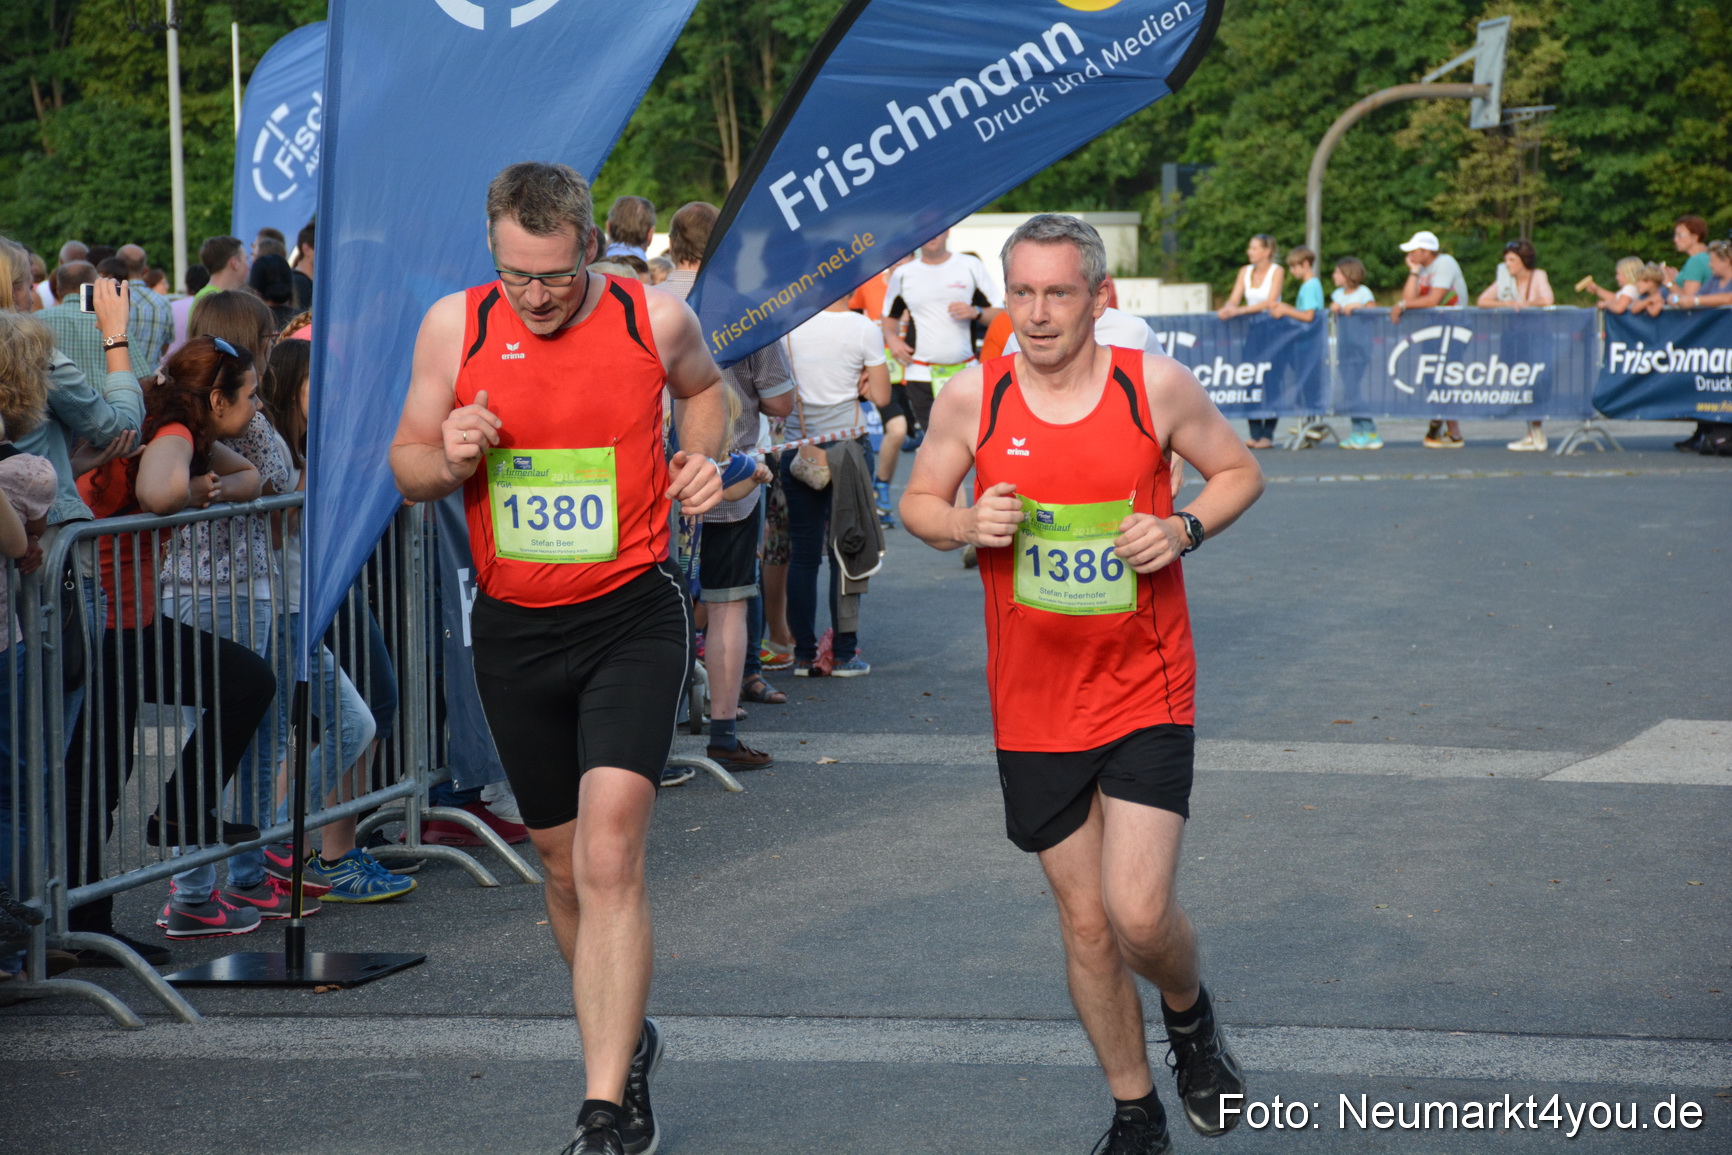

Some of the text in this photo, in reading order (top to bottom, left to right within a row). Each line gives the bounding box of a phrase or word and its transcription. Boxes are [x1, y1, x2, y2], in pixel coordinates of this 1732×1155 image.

[973, 1, 1191, 142] Druck und Medien
[769, 22, 1085, 231] Frischmann
[1415, 354, 1545, 386] Fischer
[1427, 389, 1533, 404] AUTOMOBILE
[503, 494, 603, 531] 1380
[531, 539, 554, 547] Stefan
[1025, 544, 1124, 584] 1386
[1039, 587, 1106, 600] Stefan Federhofer
